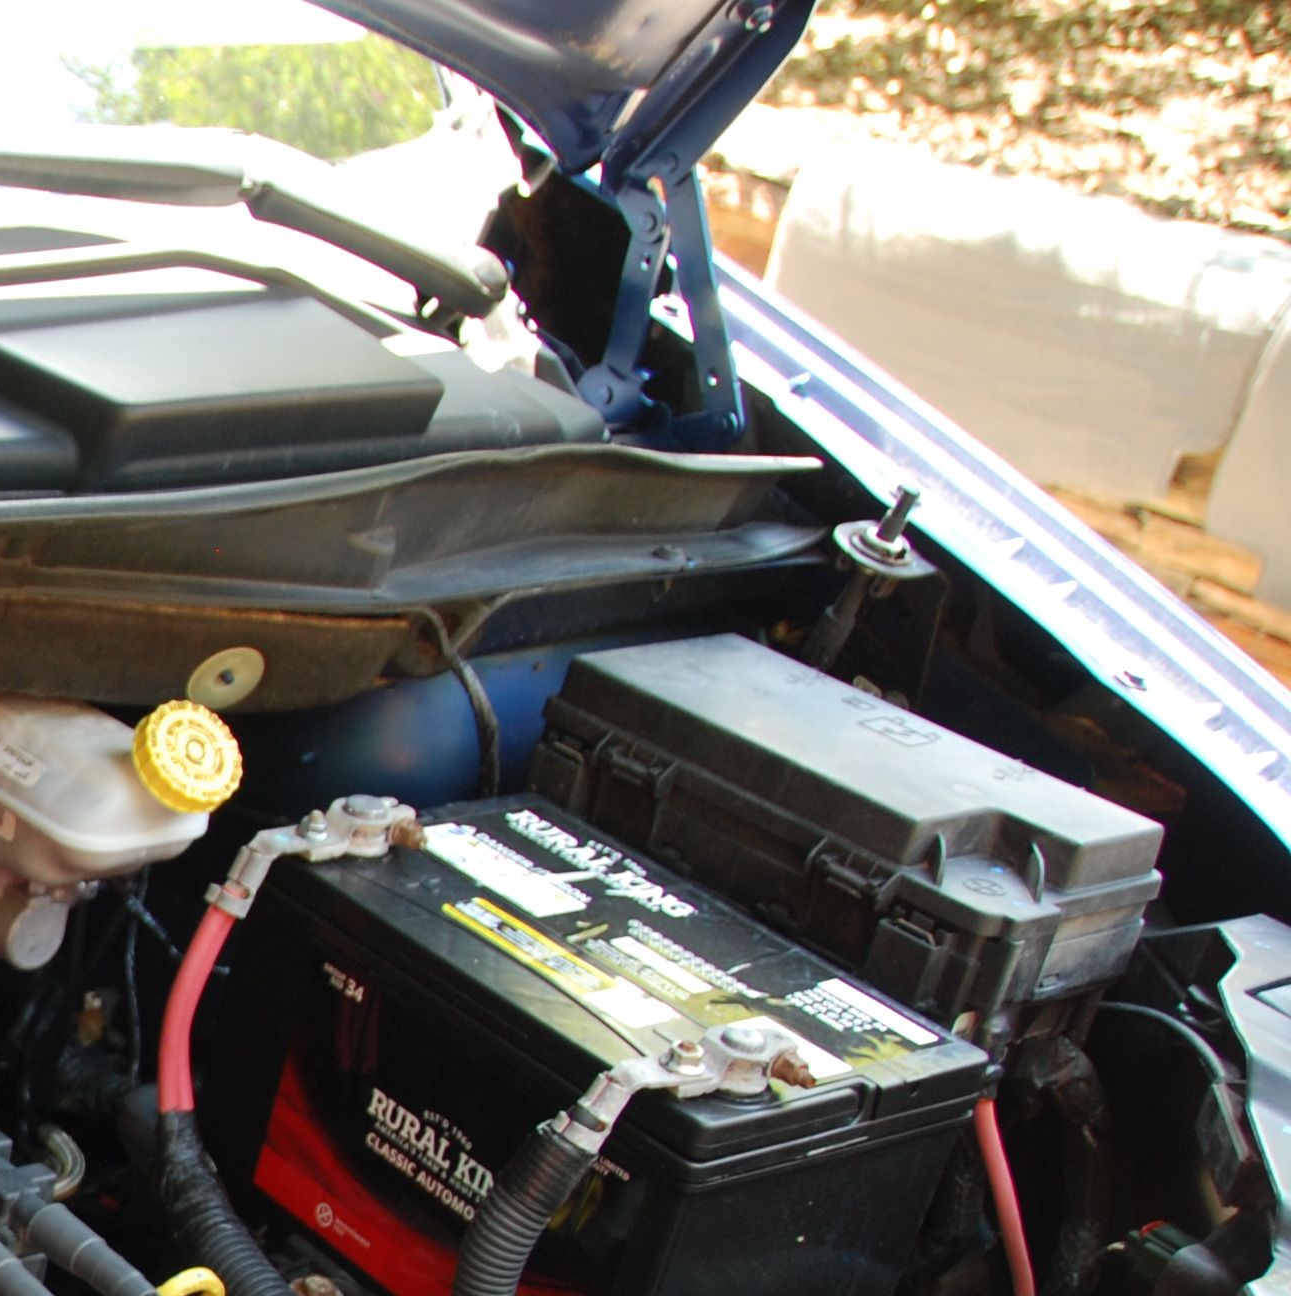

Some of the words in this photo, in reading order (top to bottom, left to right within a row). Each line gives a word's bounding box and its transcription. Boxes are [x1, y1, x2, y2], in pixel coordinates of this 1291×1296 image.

[344, 977, 365, 1003] 34
[365, 1131, 417, 1177] CLASSIC
[417, 1169, 475, 1221] AUTOMO
[367, 1087, 450, 1170] RURAL
[455, 1151, 495, 1198] KIN
